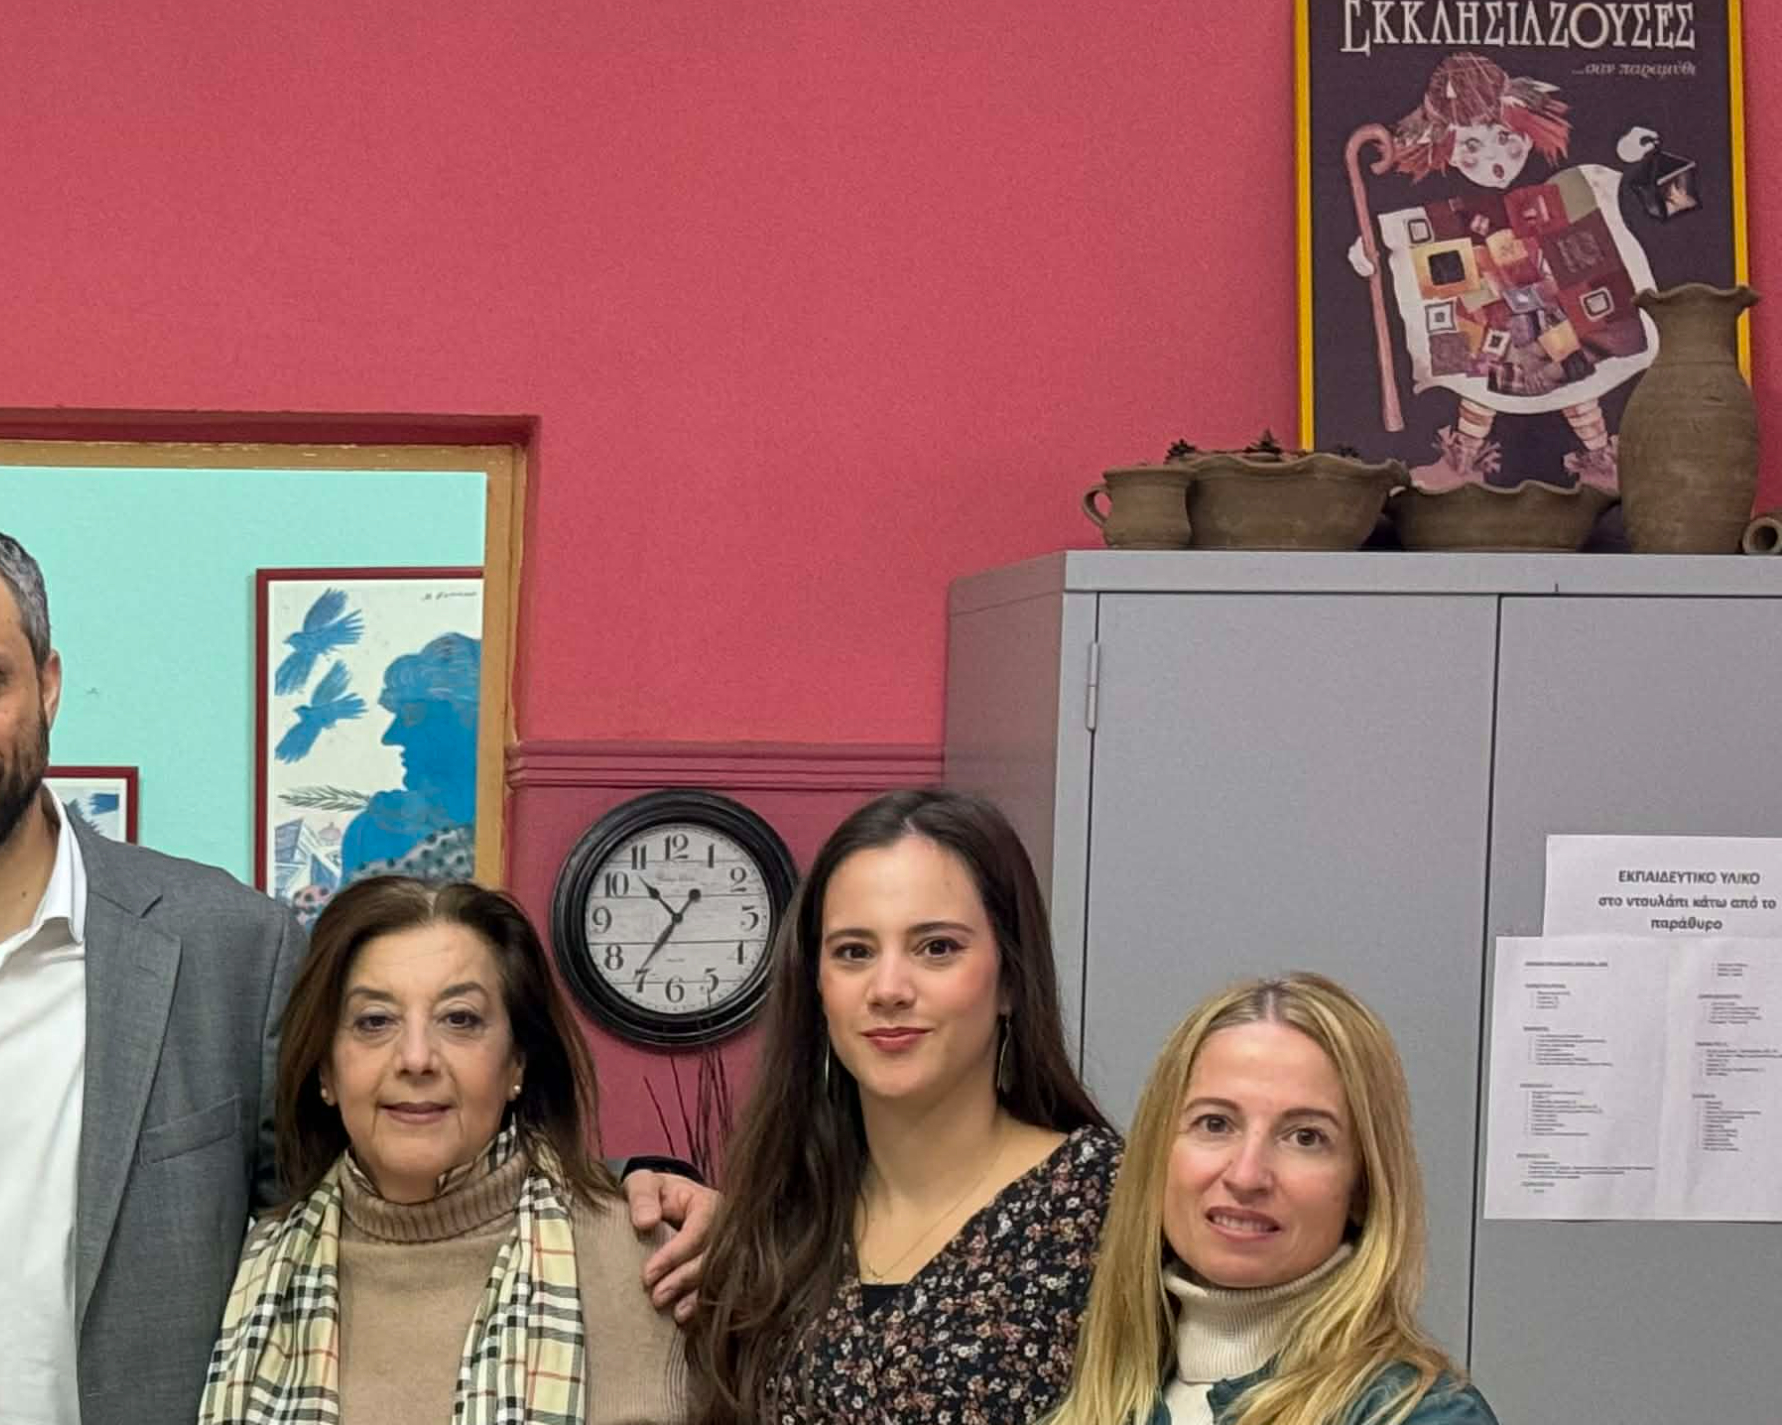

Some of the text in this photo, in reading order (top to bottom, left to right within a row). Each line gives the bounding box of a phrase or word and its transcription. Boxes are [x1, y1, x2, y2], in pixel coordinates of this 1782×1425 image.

[631, 845, 647, 870] 11
[664, 833, 689, 861] 12
[707, 843, 715, 868] 1
[605, 871, 629, 898] 10
[730, 866, 747, 893] 2
[1618, 870, 1761, 885] ΕΚΠΑΙΔΕΥΤΙΚΟ ΥΛΙΚΟ
[1598, 894, 1777, 909] στο ντουλάπι κάτω από το
[592, 906, 612, 934] 9
[1651, 916, 1723, 933] παράθυρο
[604, 945, 624, 971] 8
[634, 967, 651, 993] 7
[665, 976, 685, 1003] 6
